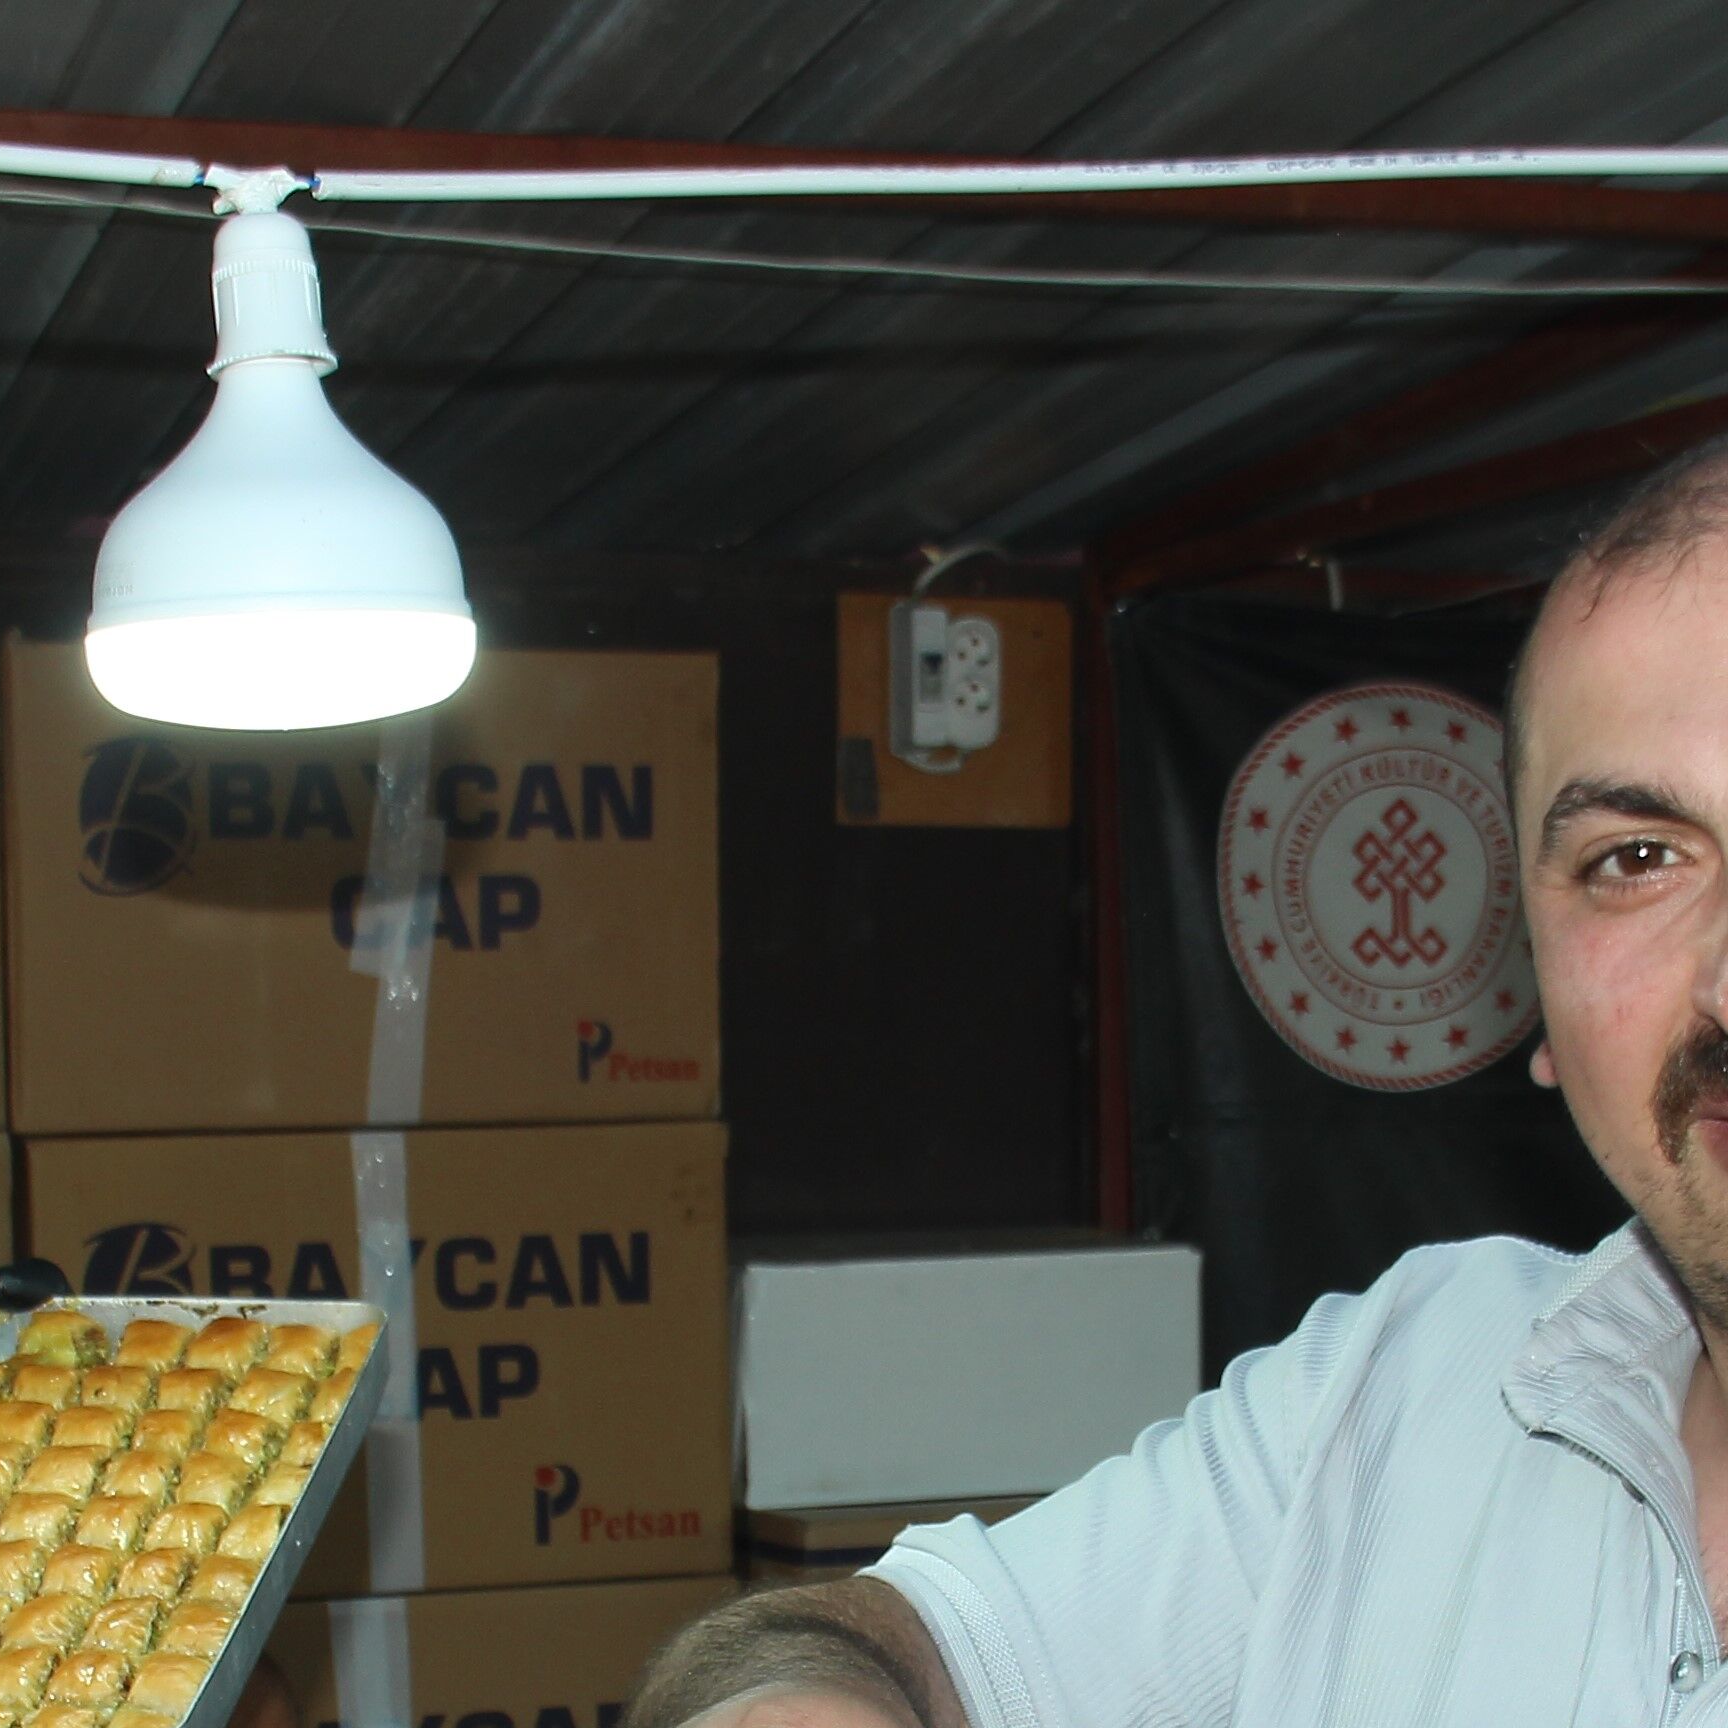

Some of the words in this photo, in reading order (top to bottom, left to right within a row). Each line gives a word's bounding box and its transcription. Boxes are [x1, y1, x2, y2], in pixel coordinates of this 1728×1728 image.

[607, 1052, 699, 1083] Petsan
[209, 1231, 651, 1311] BACAN
[580, 1503, 702, 1544] Petsan
